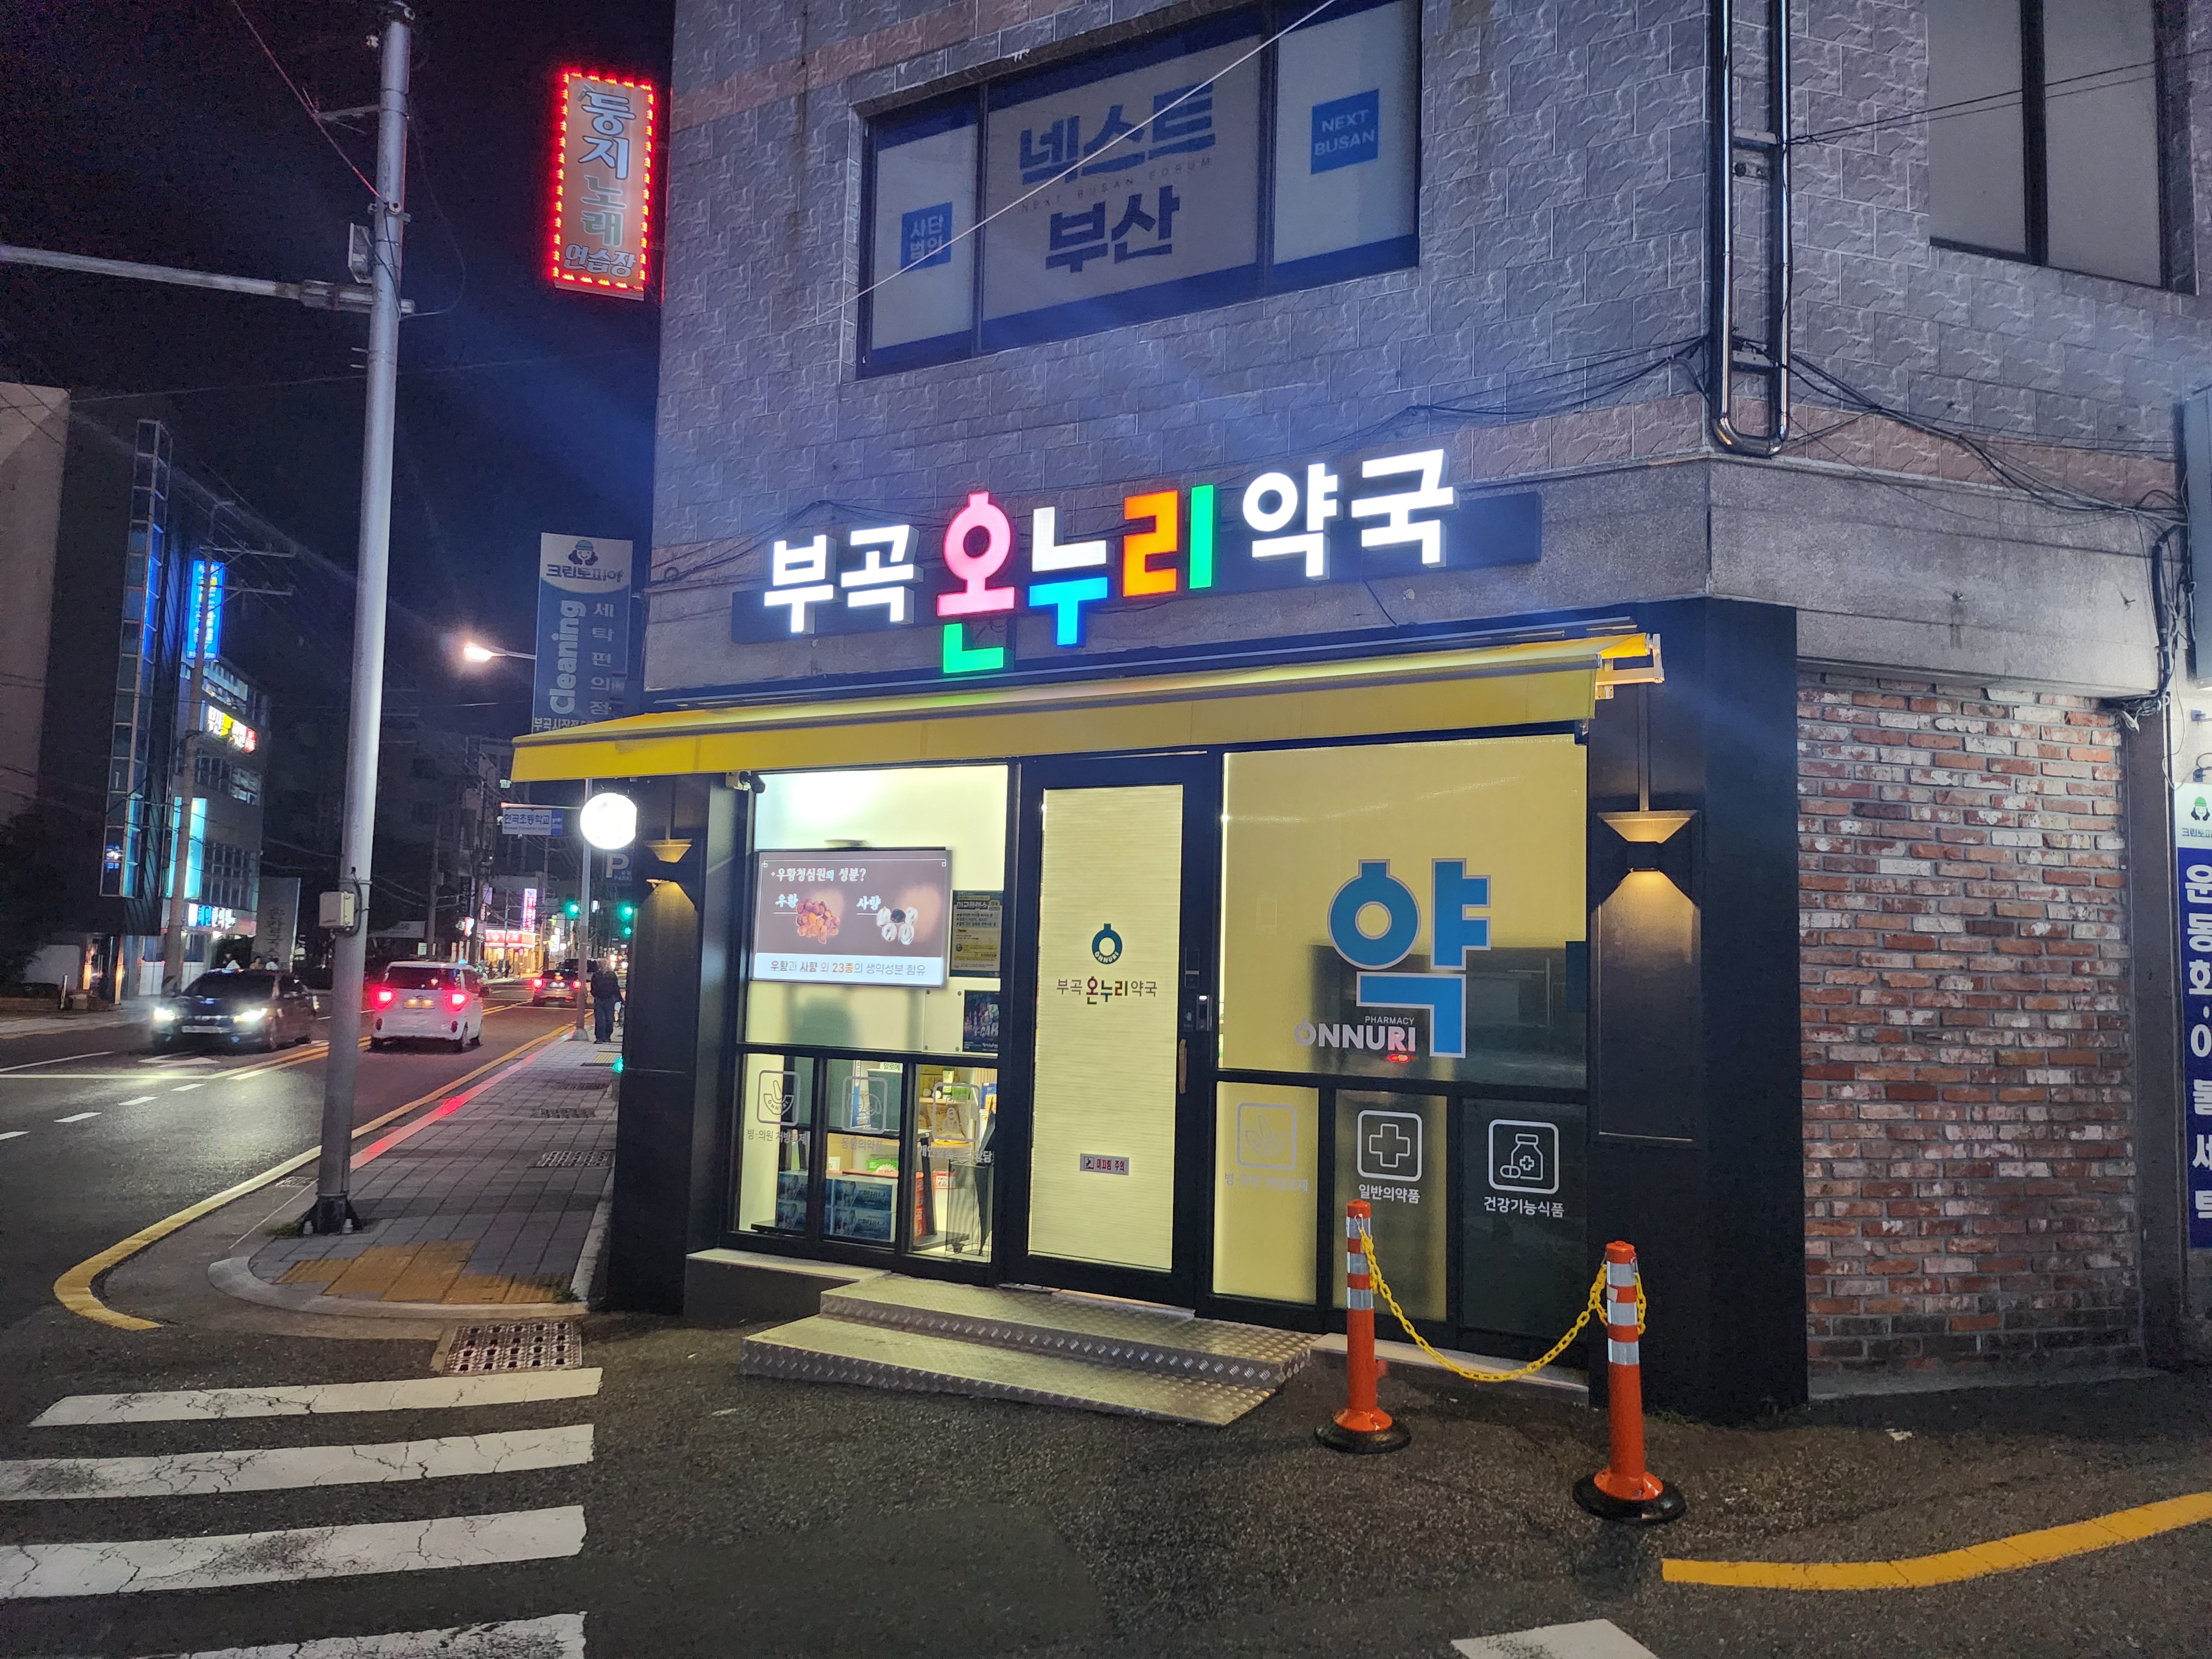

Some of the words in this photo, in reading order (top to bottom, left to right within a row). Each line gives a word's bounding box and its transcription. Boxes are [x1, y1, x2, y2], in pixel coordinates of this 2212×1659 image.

[1020, 81, 1215, 185] 넥스트
[1321, 109, 1369, 133] NEXT
[577, 91, 637, 180] 둥지
[1314, 129, 1375, 156] BUSAN
[1148, 158, 1211, 181] FORUM
[581, 174, 628, 247] 노래
[910, 213, 943, 239] 사단
[1046, 185, 1180, 273] 부산
[564, 243, 636, 278] 연습장
[546, 564, 624, 583] 크린토피아
[764, 524, 922, 634] 부곡
[937, 484, 1217, 674] 온누리
[1241, 449, 1457, 578] 약국
[549, 600, 586, 714] Cleaning
[590, 602, 614, 716] 세탁편의점
[606, 854, 629, 878] P
[776, 867, 834, 882] 우황청심원의
[838, 867, 867, 882] 성분?
[775, 893, 799, 909] 우황
[856, 895, 881, 911] 사향
[800, 961, 818, 973] 사향
[832, 962, 863, 974] 23종의
[867, 963, 904, 975] 생약성분
[907, 964, 926, 976] 함유
[1094, 951, 1120, 963] ONNURI
[1328, 858, 1491, 1058] 약
[1057, 979, 1083, 995] 부곡
[1086, 976, 1128, 1005] 온누리
[1131, 980, 1158, 997] 약국
[1365, 1016, 1415, 1025] PHARMACY
[1293, 1018, 1416, 1052] ONNURI
[775, 1130, 807, 1144] 처방제
[841, 1137, 884, 1152] 동물의약품
[1115, 1160, 1125, 1172] 주의
[1358, 1183, 1421, 1204] 일반의약품
[1484, 1196, 1565, 1218] 건강기능식품
